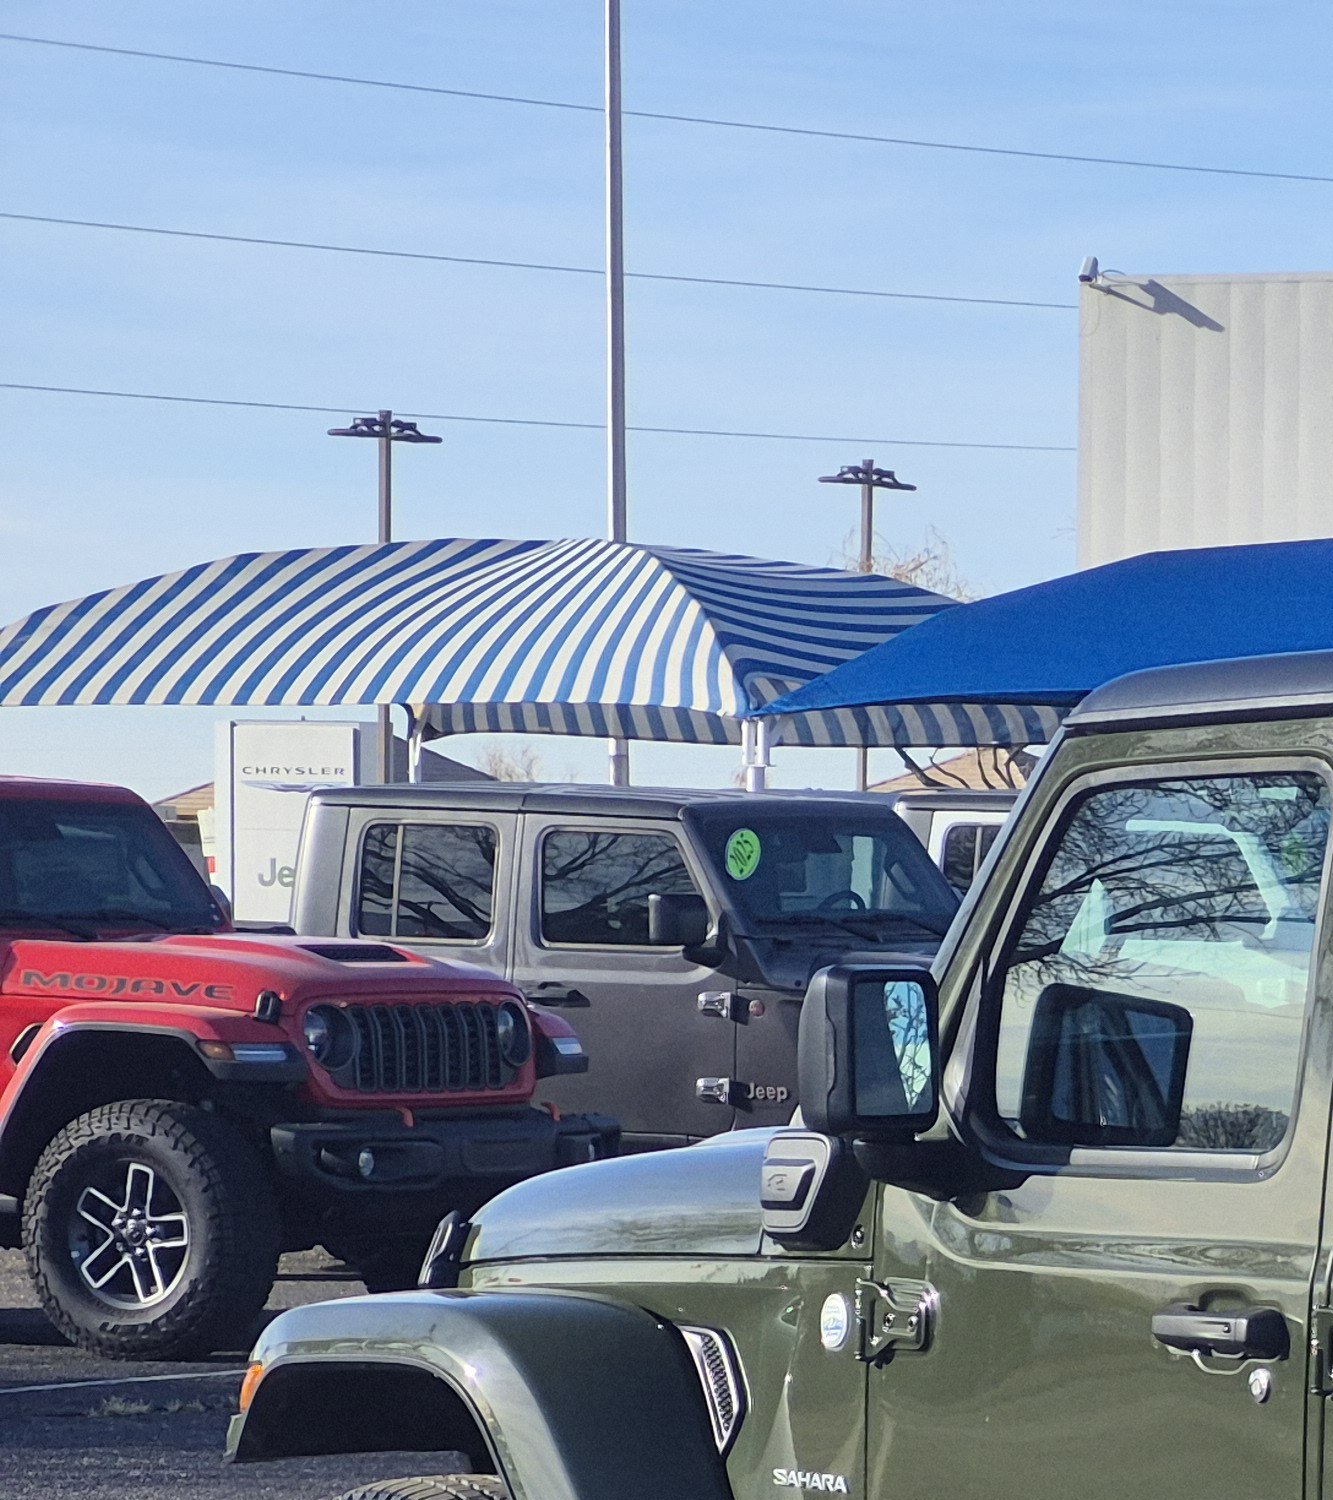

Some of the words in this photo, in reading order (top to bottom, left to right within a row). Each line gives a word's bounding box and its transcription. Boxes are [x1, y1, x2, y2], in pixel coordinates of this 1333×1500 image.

[242, 766, 345, 776] CHRYSLER
[258, 858, 296, 887] Je
[21, 969, 234, 1000] MOJAVE
[747, 1082, 788, 1102] Jeep
[773, 1468, 848, 1494] SAHARA
